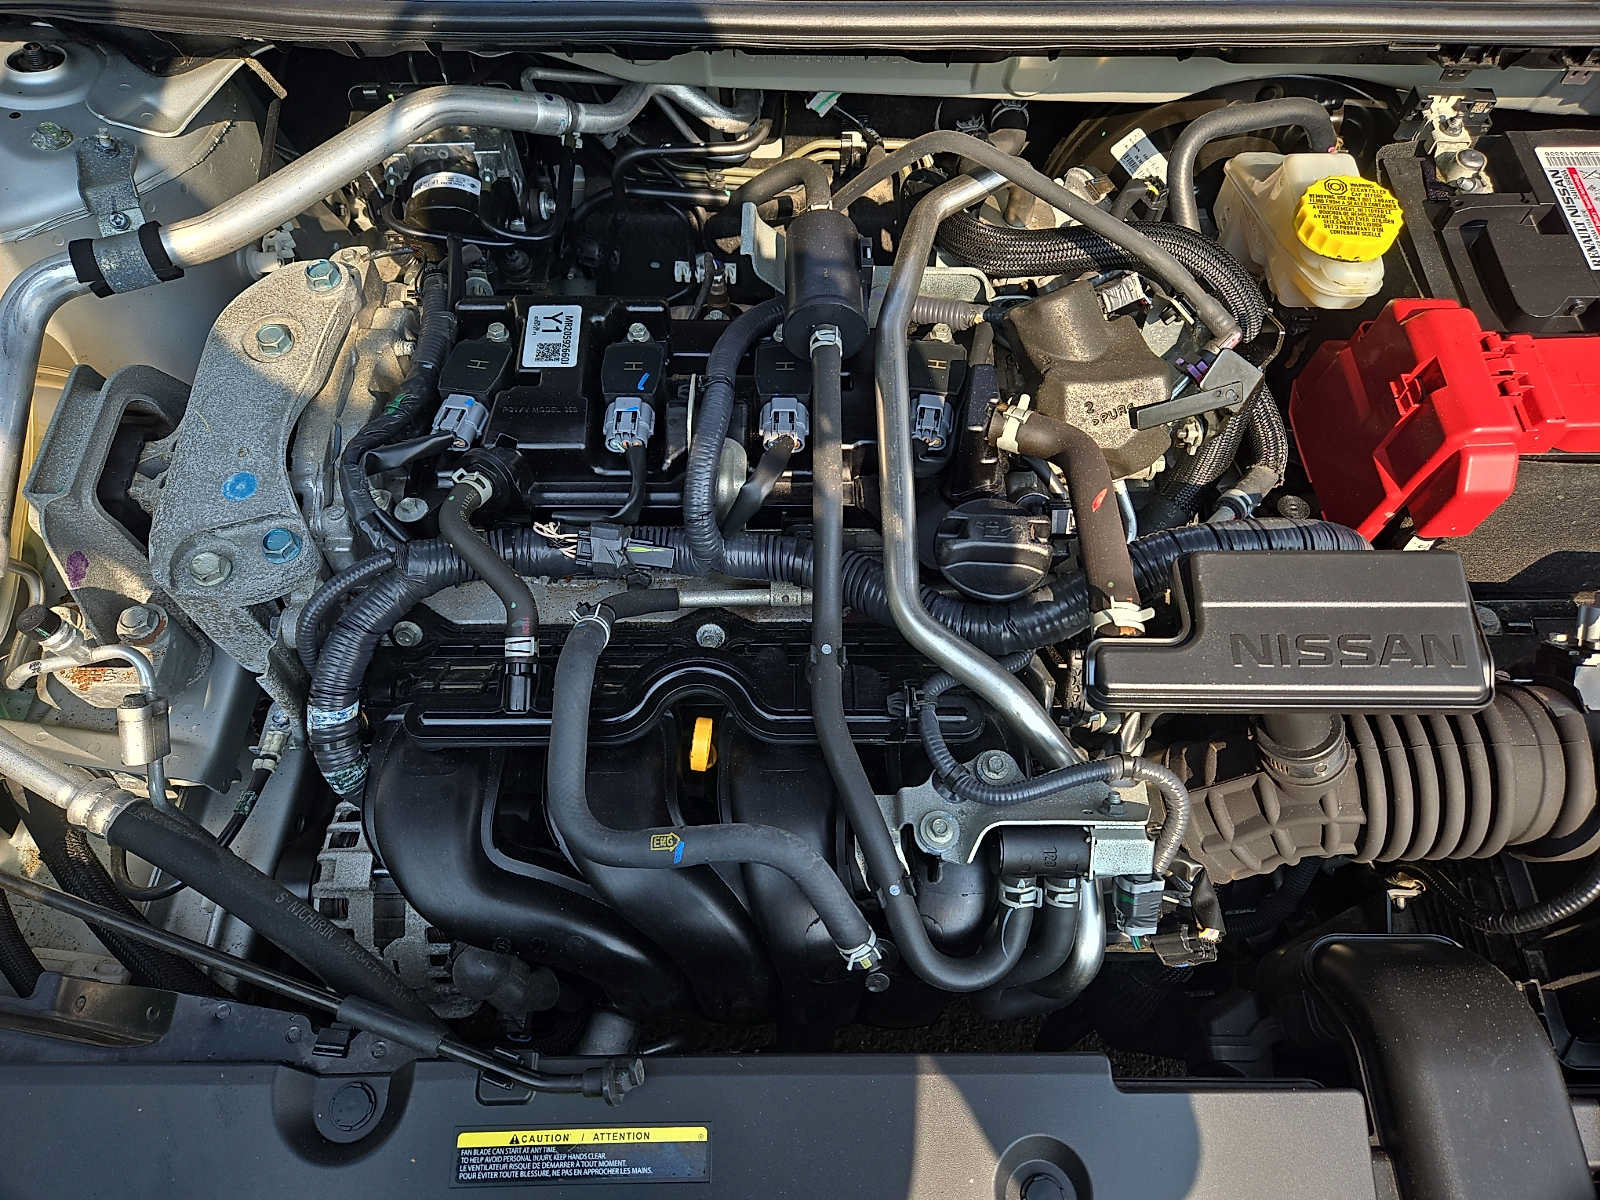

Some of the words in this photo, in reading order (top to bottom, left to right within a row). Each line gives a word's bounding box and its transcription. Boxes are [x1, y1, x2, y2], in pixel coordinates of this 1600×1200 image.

[1549, 169, 1580, 218] NISSAN
[542, 311, 563, 333] Y1
[1229, 632, 1468, 669] NISSAN
[521, 1133, 570, 1144] CAUTION
[592, 1132, 650, 1142] ATTENTION
[459, 1172, 476, 1180] POUR
[583, 1167, 620, 1175] APPROCHER
